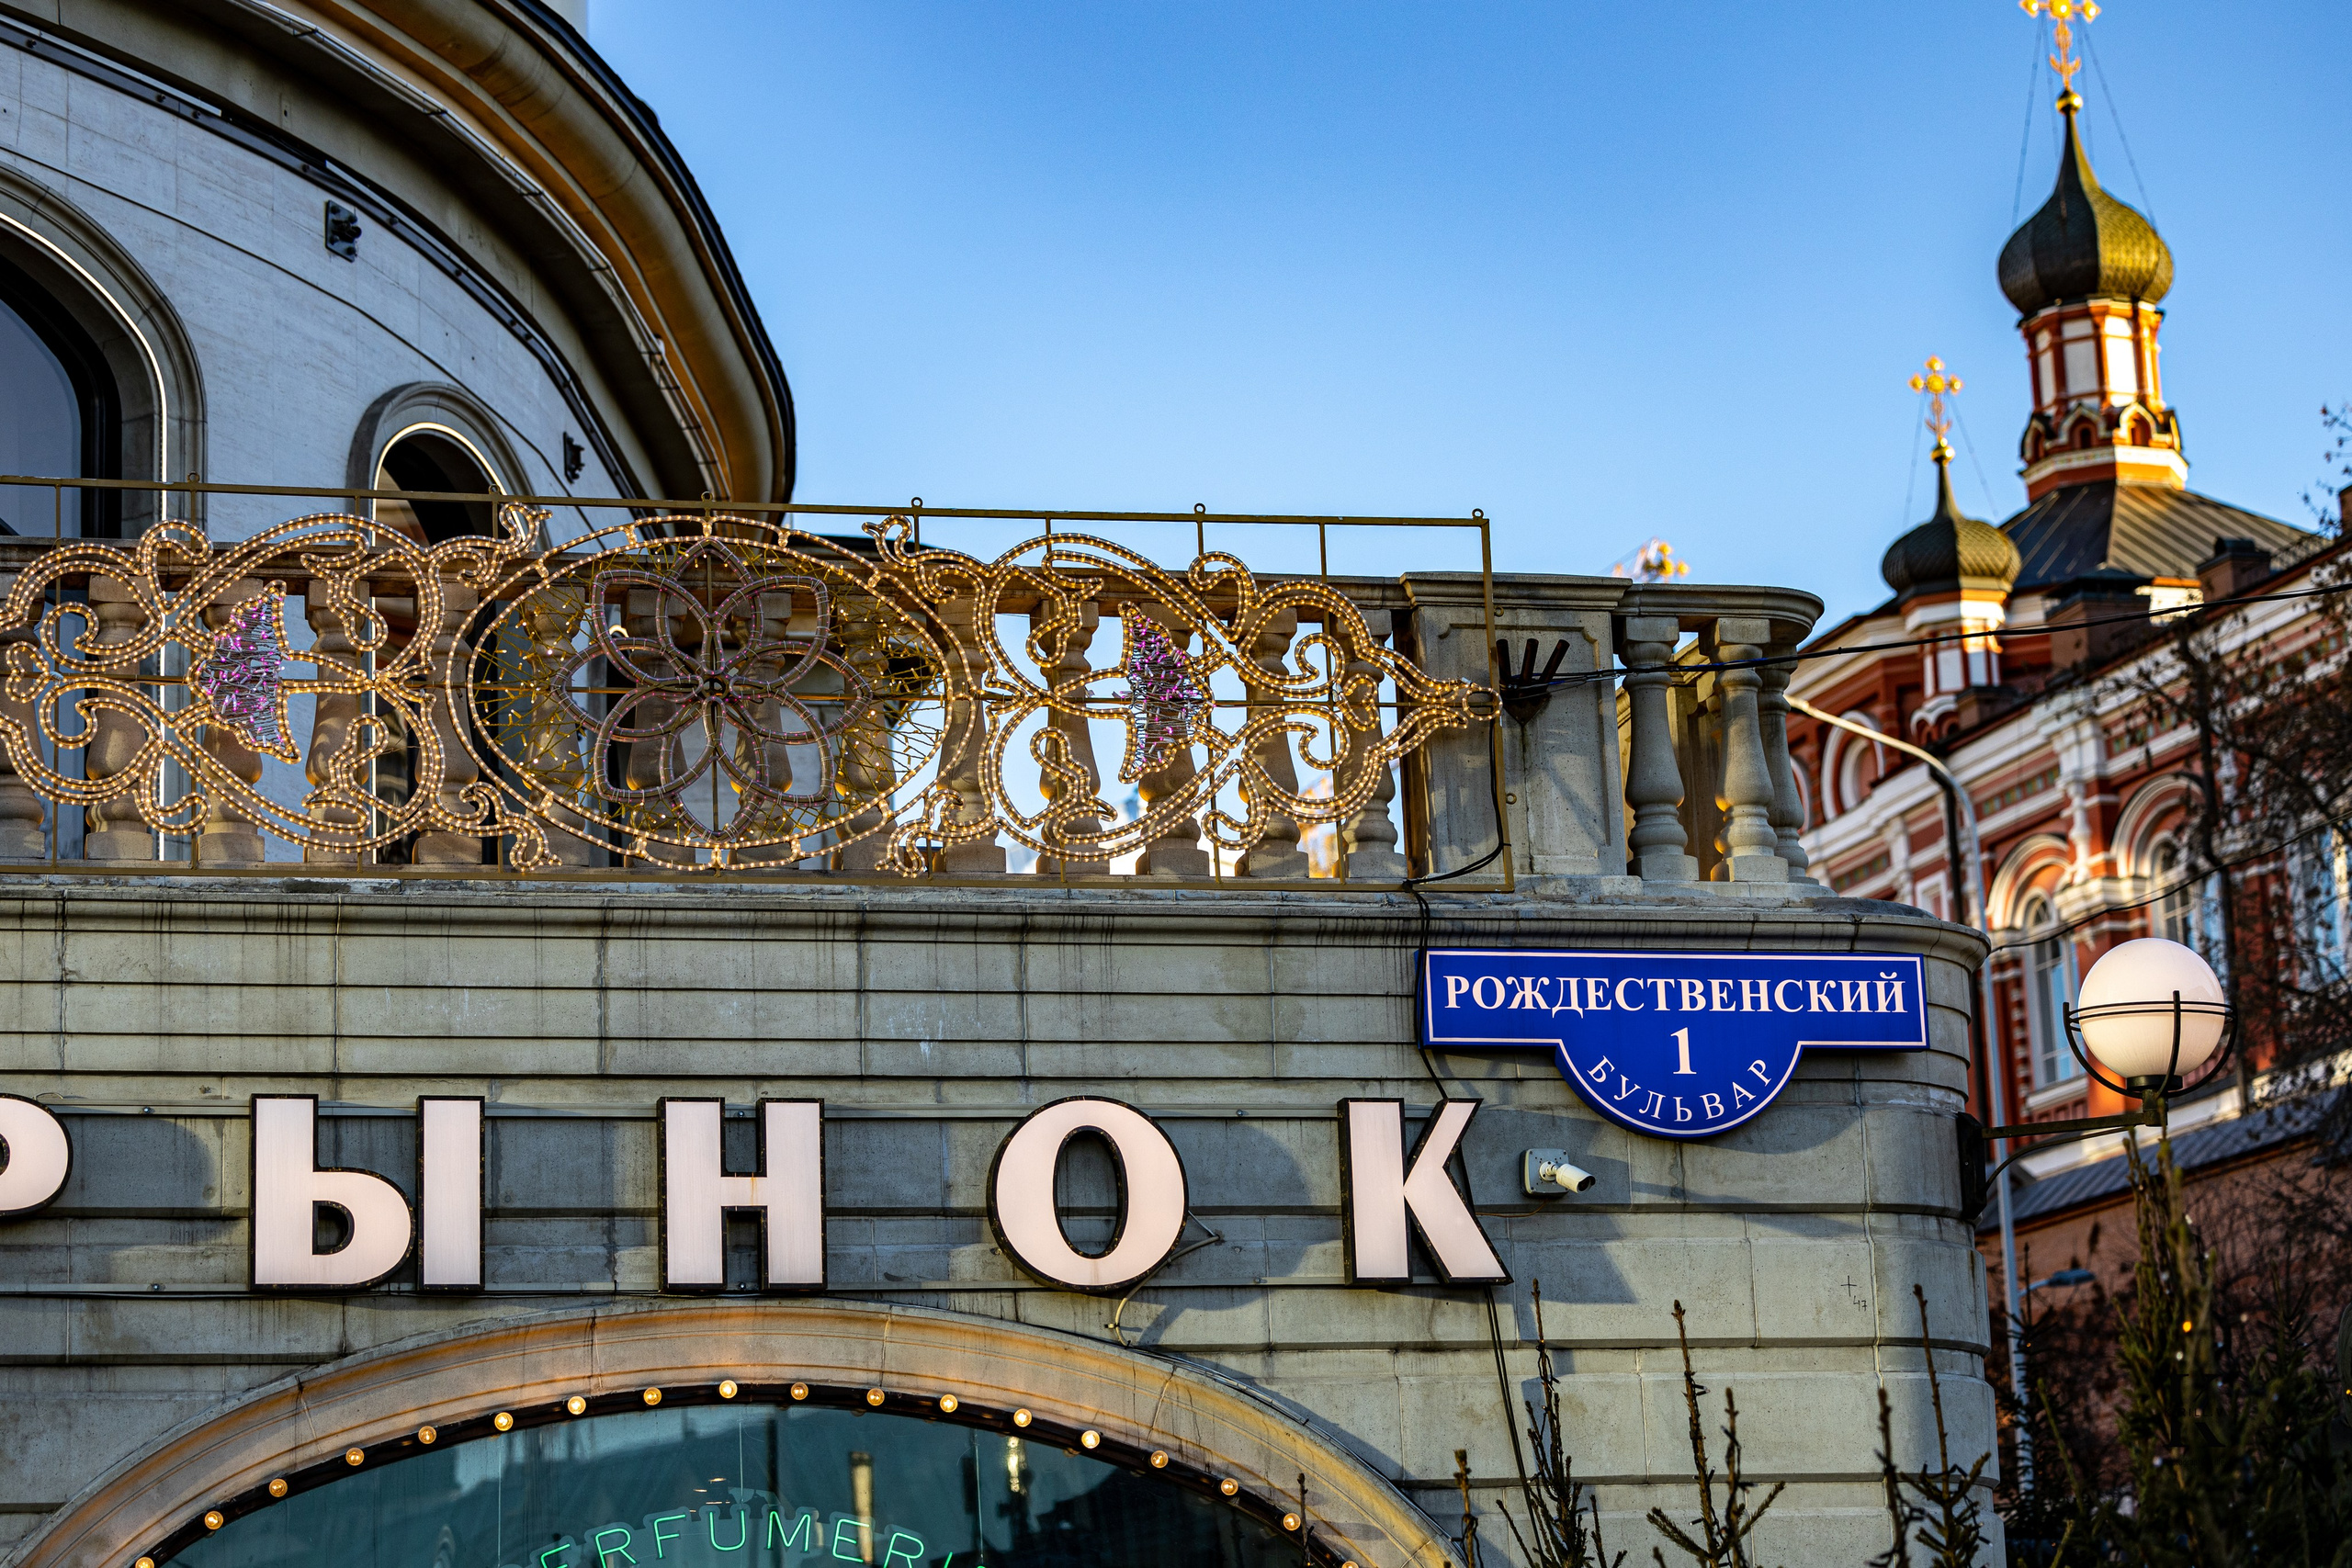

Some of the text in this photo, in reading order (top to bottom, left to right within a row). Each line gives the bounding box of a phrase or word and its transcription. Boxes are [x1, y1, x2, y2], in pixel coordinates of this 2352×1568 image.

[1442, 971, 1908, 1020] РОЖДЕСТВЕНСКИЙ
[1669, 1026, 1698, 1076] 1
[1587, 1055, 1772, 1122] БУЛЬВАР
[540, 1509, 987, 1568] ERFUMER
